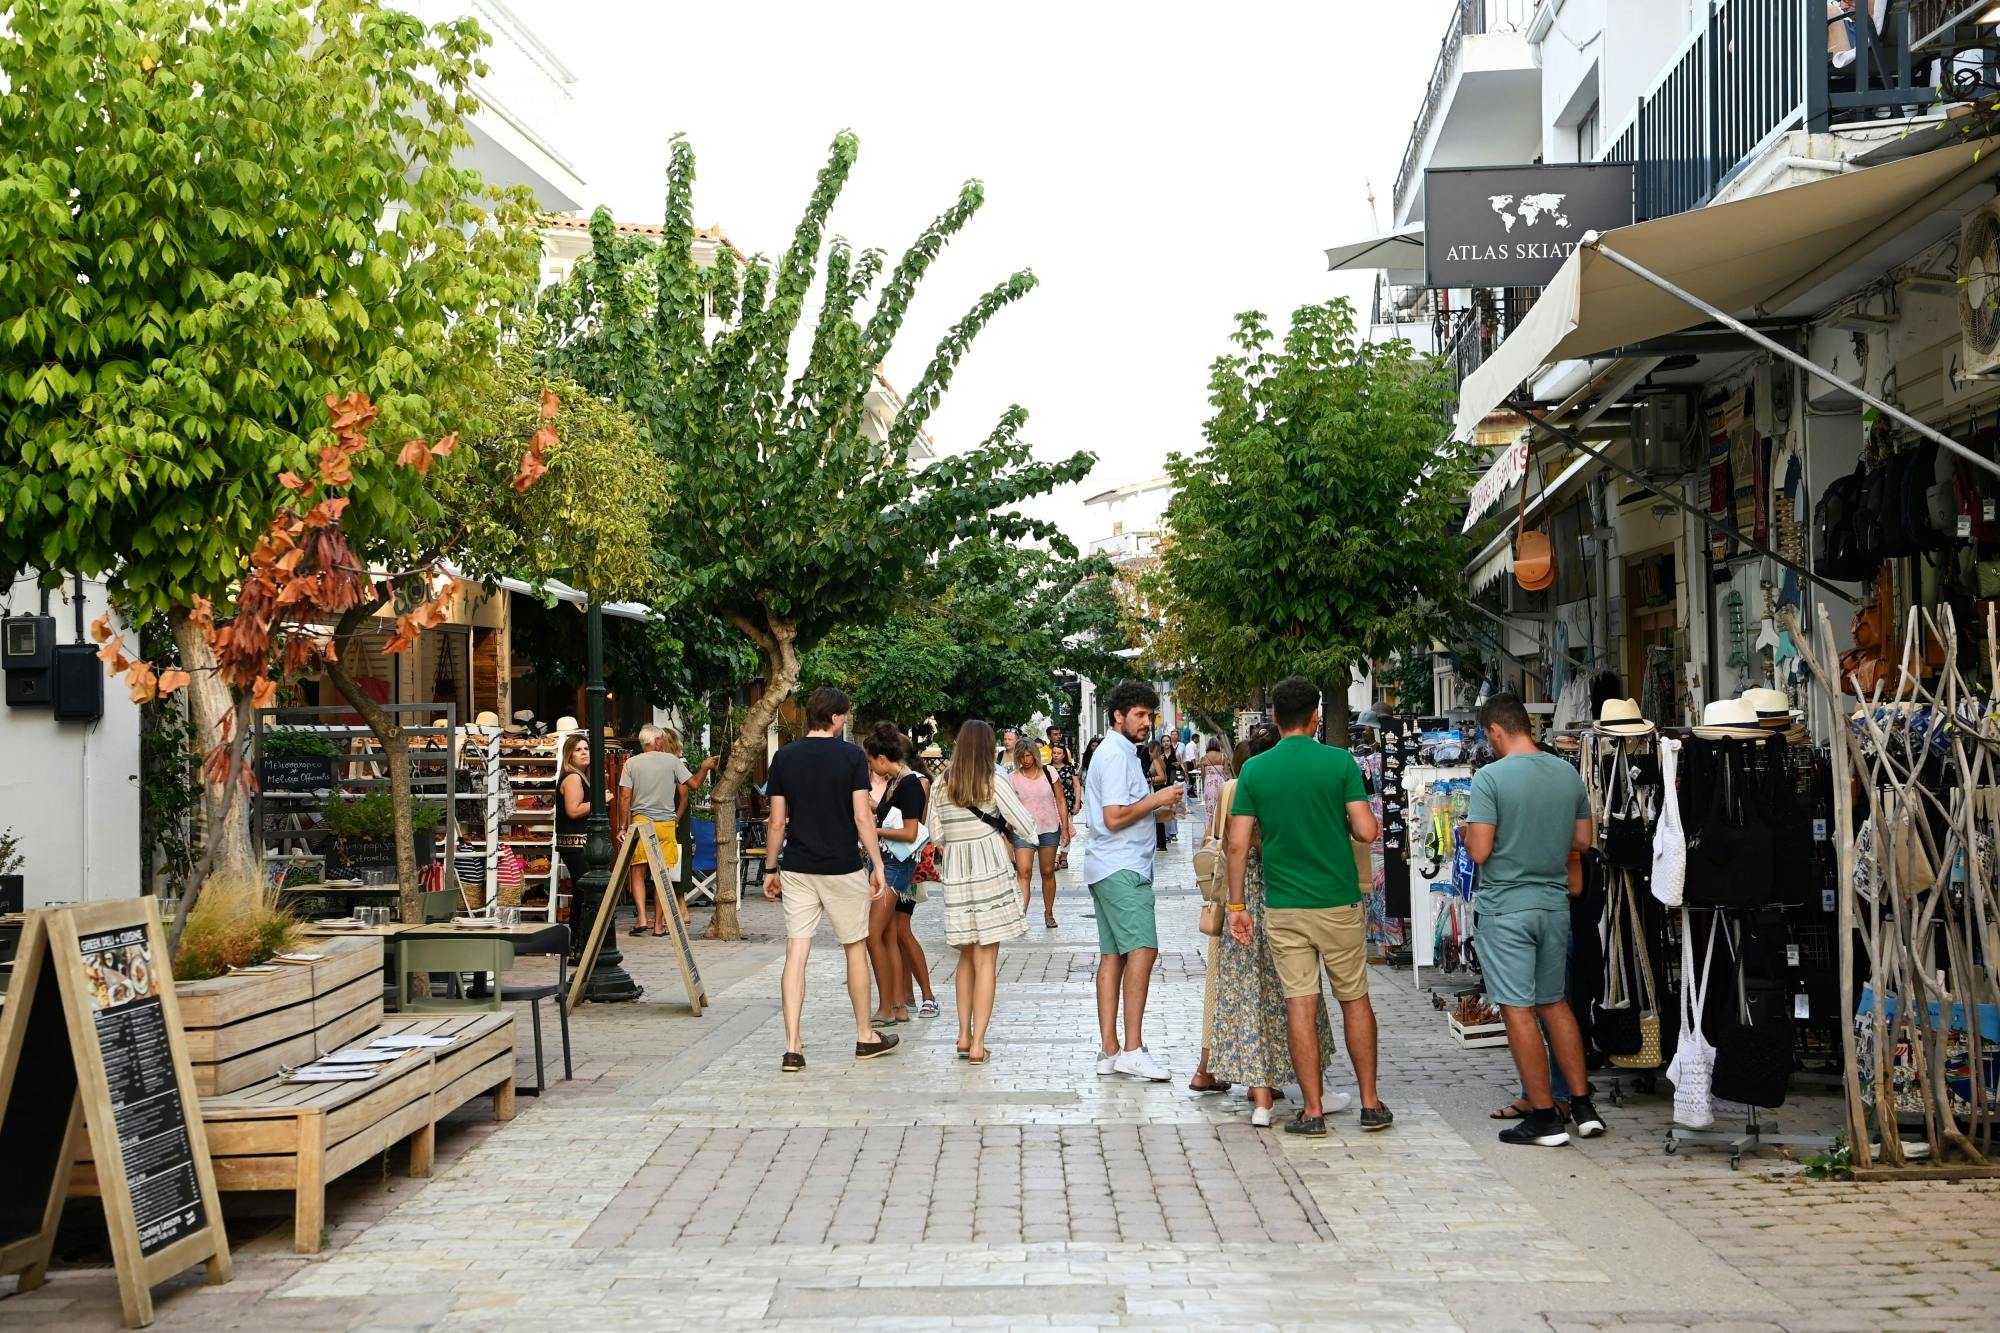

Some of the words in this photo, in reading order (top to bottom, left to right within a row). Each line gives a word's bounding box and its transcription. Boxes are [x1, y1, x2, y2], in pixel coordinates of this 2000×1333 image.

[1446, 244, 1508, 261] ATLAS
[1516, 242, 1581, 259] SKIAT
[267, 774, 299, 784] Melissa
[81, 938, 100, 951] GREEK
[101, 934, 115, 946] DELI
[120, 929, 144, 943] CUISINE
[139, 1224, 161, 1241] Cooking
[160, 1215, 182, 1231] Lessons
